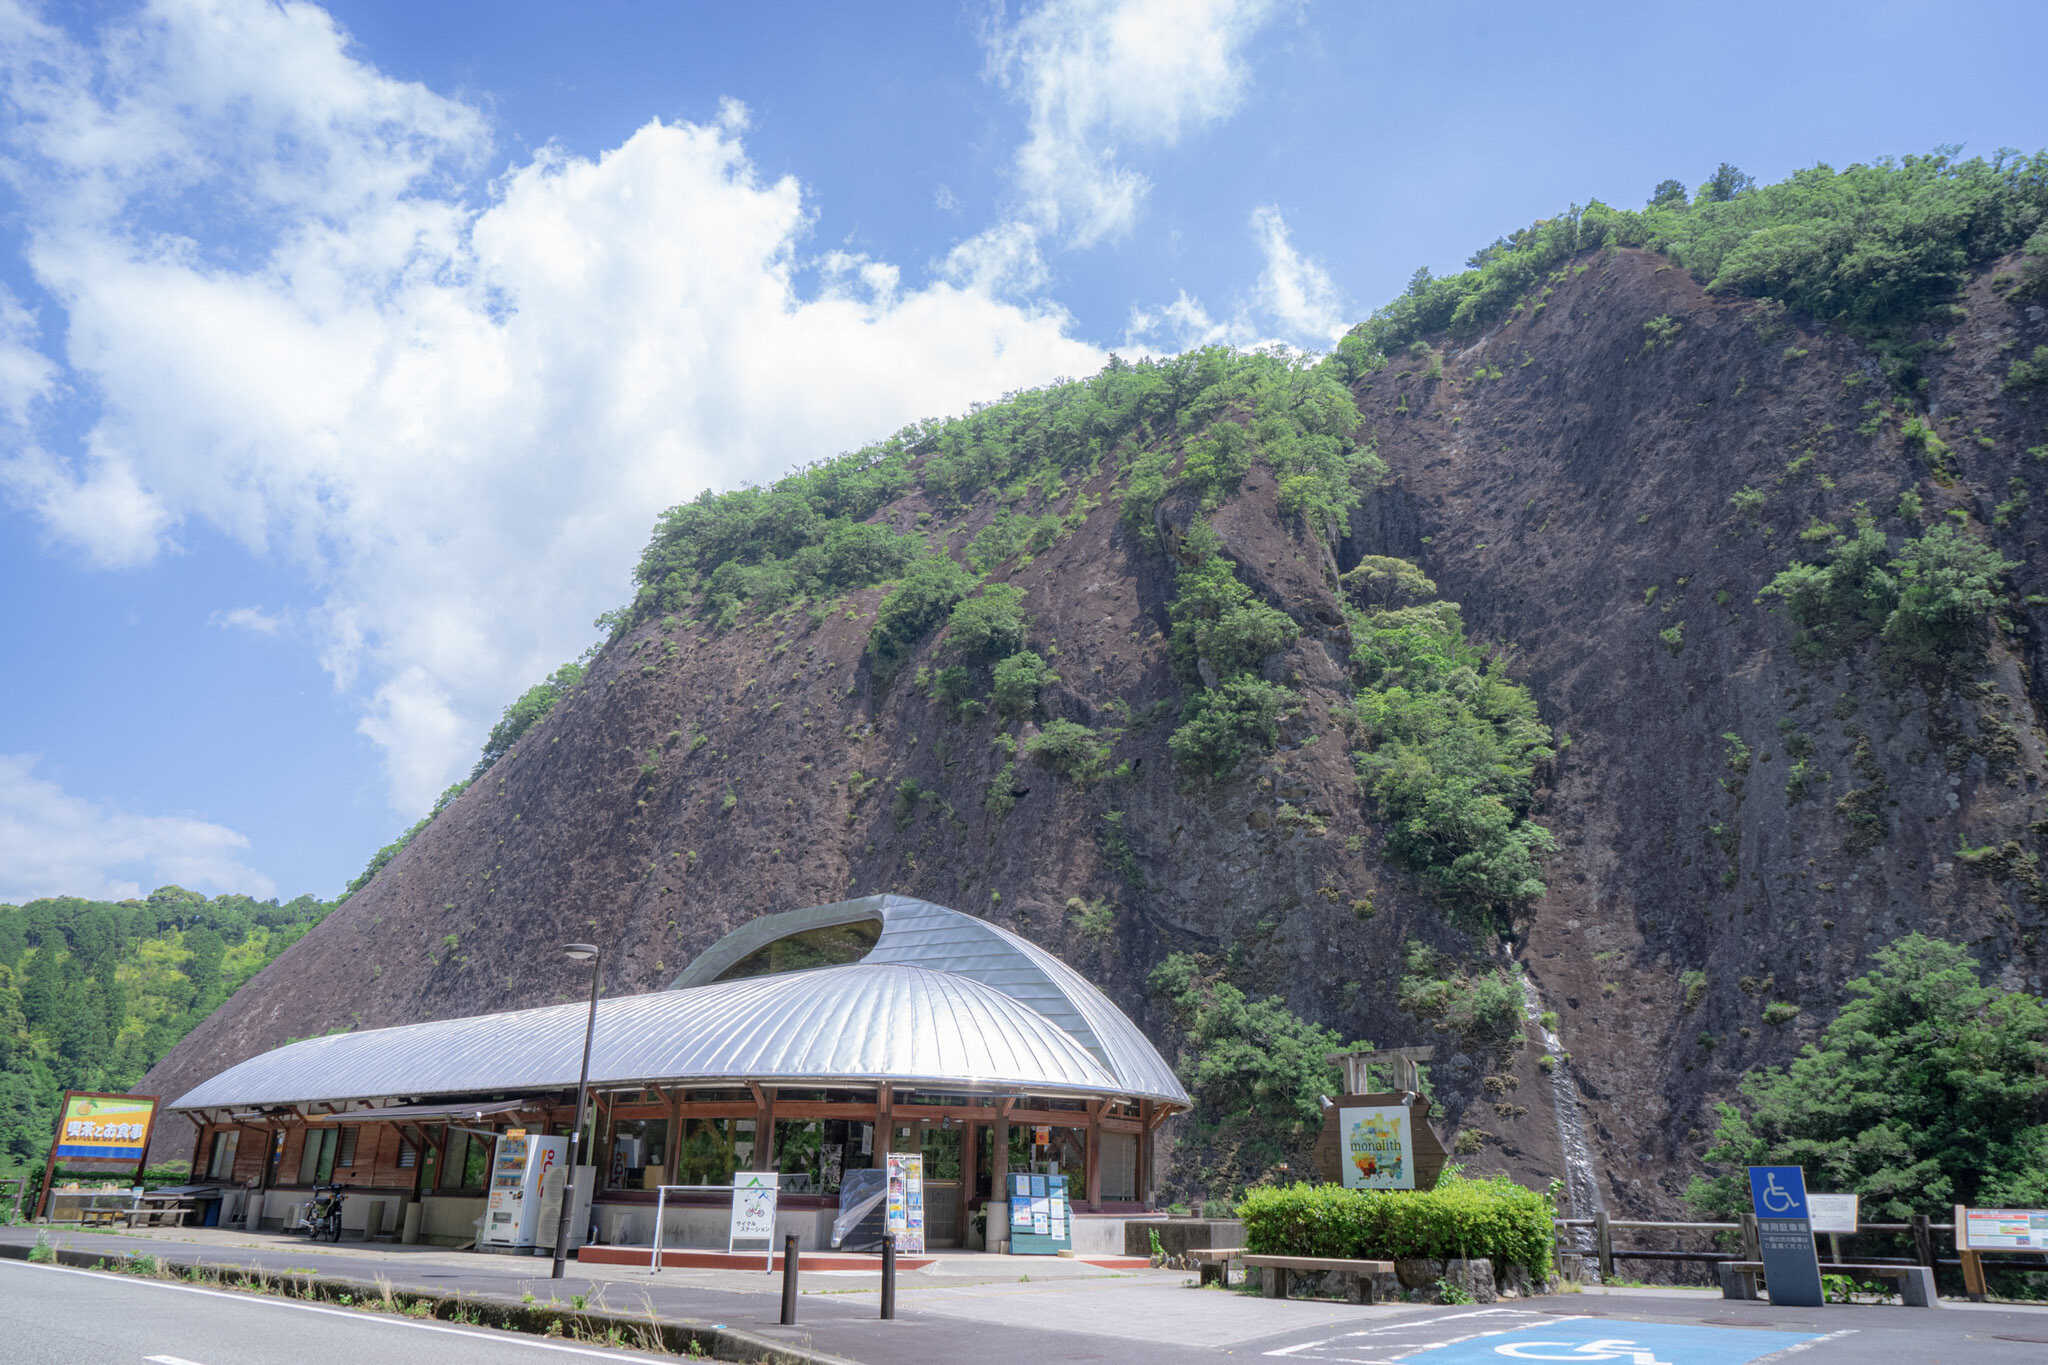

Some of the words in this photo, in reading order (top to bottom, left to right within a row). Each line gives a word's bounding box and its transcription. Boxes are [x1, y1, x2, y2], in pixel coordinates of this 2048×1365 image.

[66, 1121, 143, 1139] 喫茶とお食事
[1351, 1139, 1402, 1152] monolith
